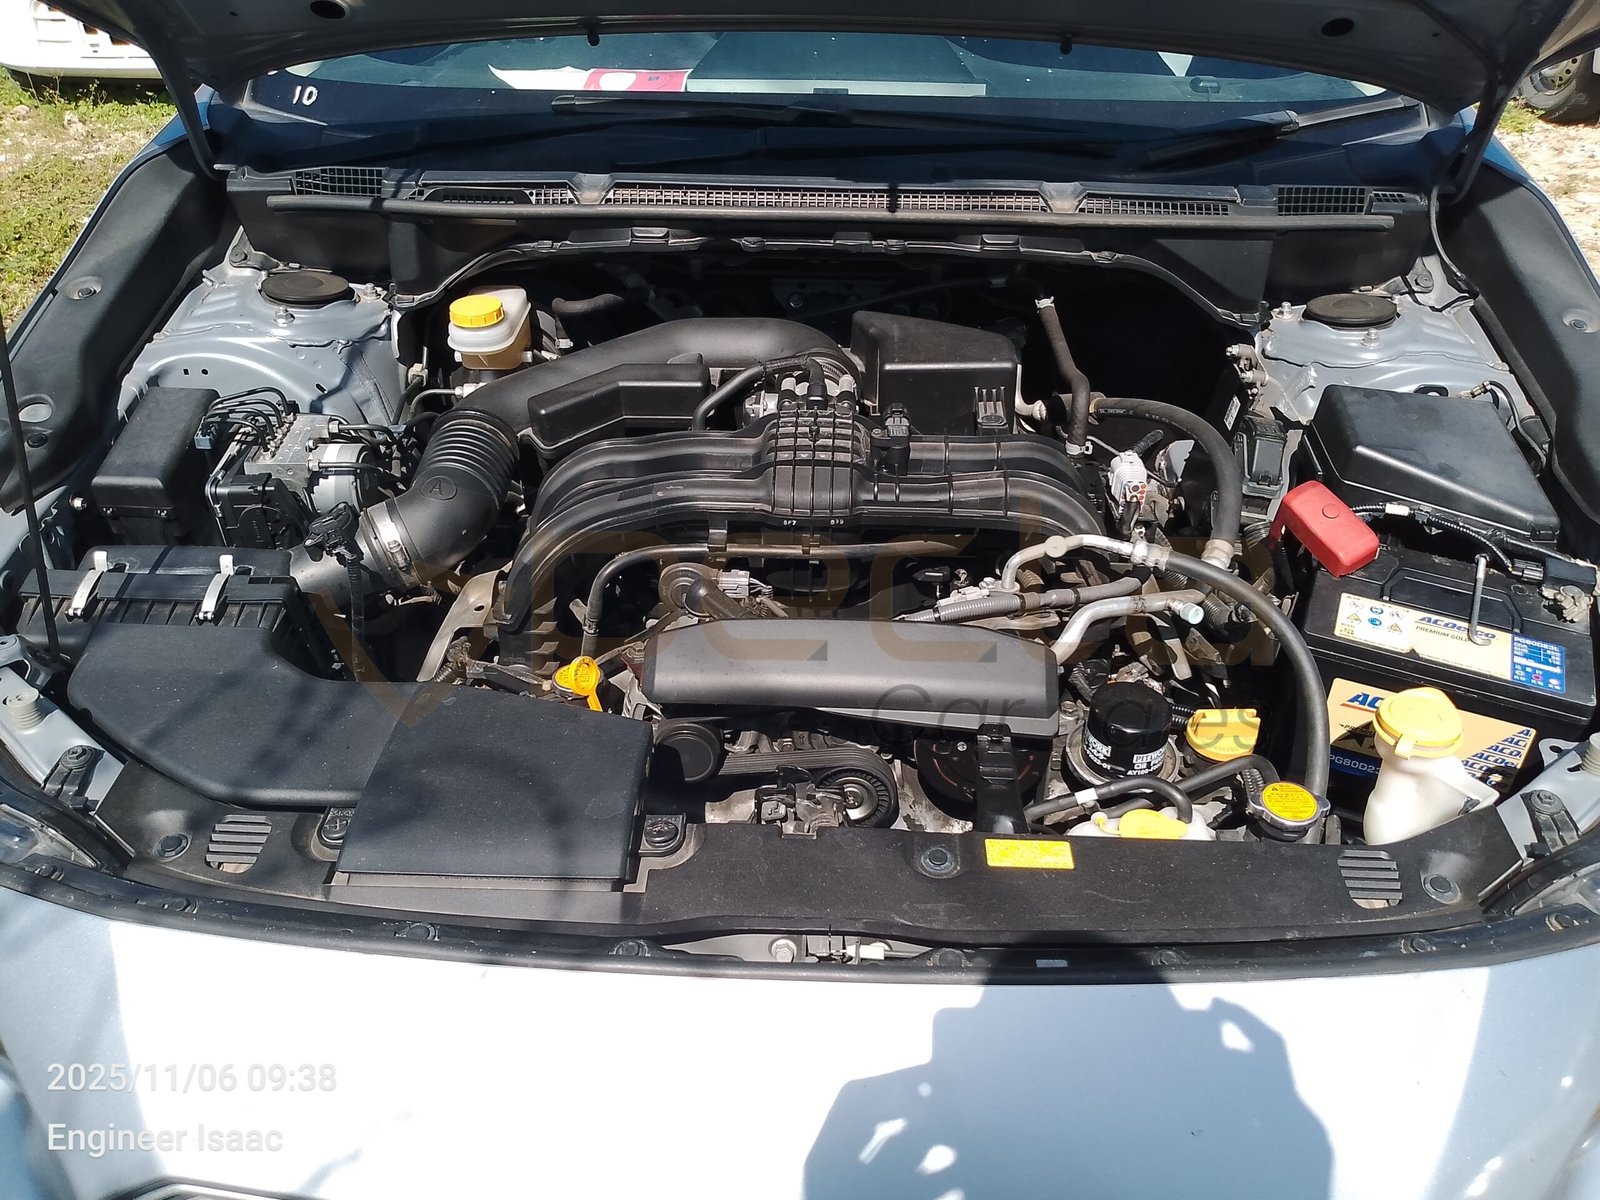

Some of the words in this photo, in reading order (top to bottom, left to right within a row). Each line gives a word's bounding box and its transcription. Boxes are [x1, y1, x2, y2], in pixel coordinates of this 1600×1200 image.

[292, 85, 318, 106] 10
[1415, 625, 1449, 638] PREMIUM
[1450, 633, 1470, 643] GOLD
[1418, 616, 1496, 639] ACDeco
